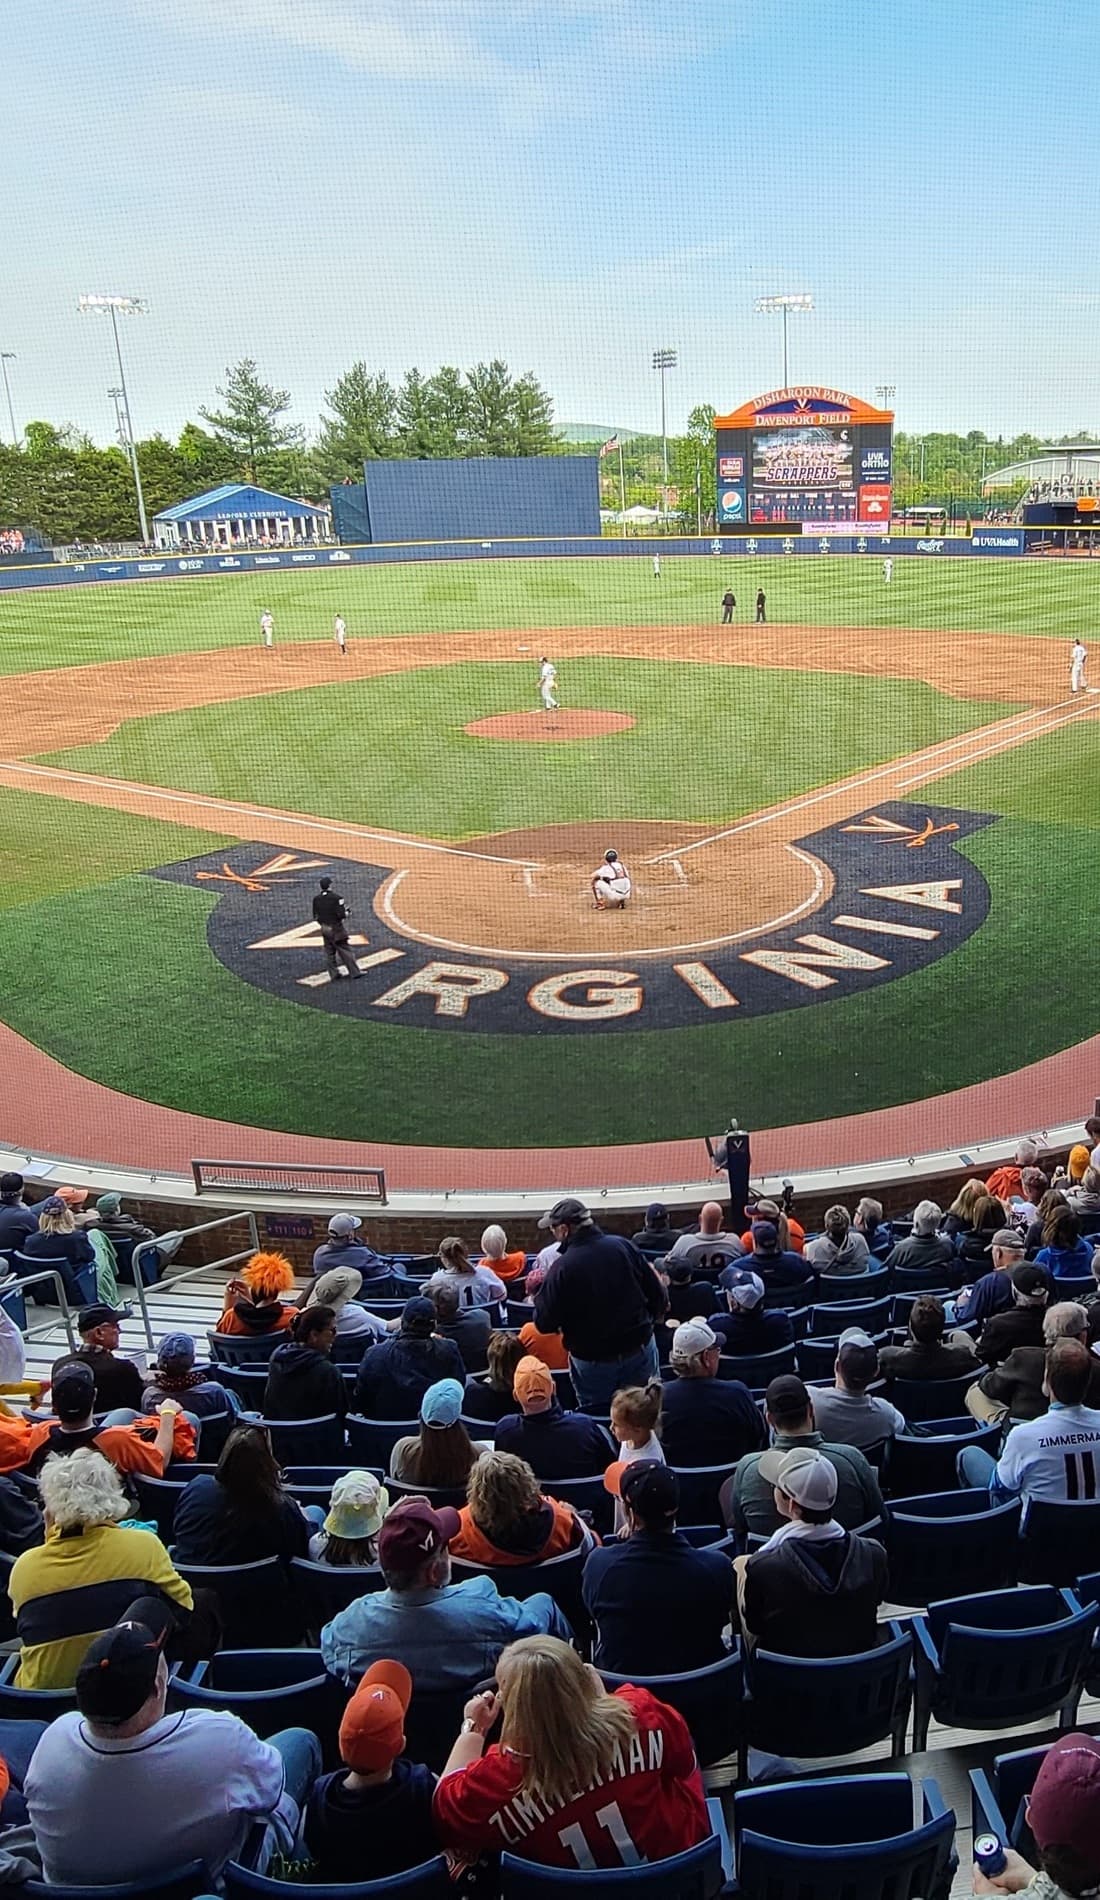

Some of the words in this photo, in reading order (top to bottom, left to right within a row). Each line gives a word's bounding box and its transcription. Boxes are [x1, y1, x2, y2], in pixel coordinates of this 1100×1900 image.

[753, 387, 820, 409] DISHAROON
[823, 390, 851, 407] PARK
[756, 415, 815, 426] DAVENPORT
[820, 413, 850, 425] FIELD
[767, 466, 838, 480] SCRAPPERS
[1063, 1450, 1096, 1501] 11
[557, 1800, 649, 1870] 11
